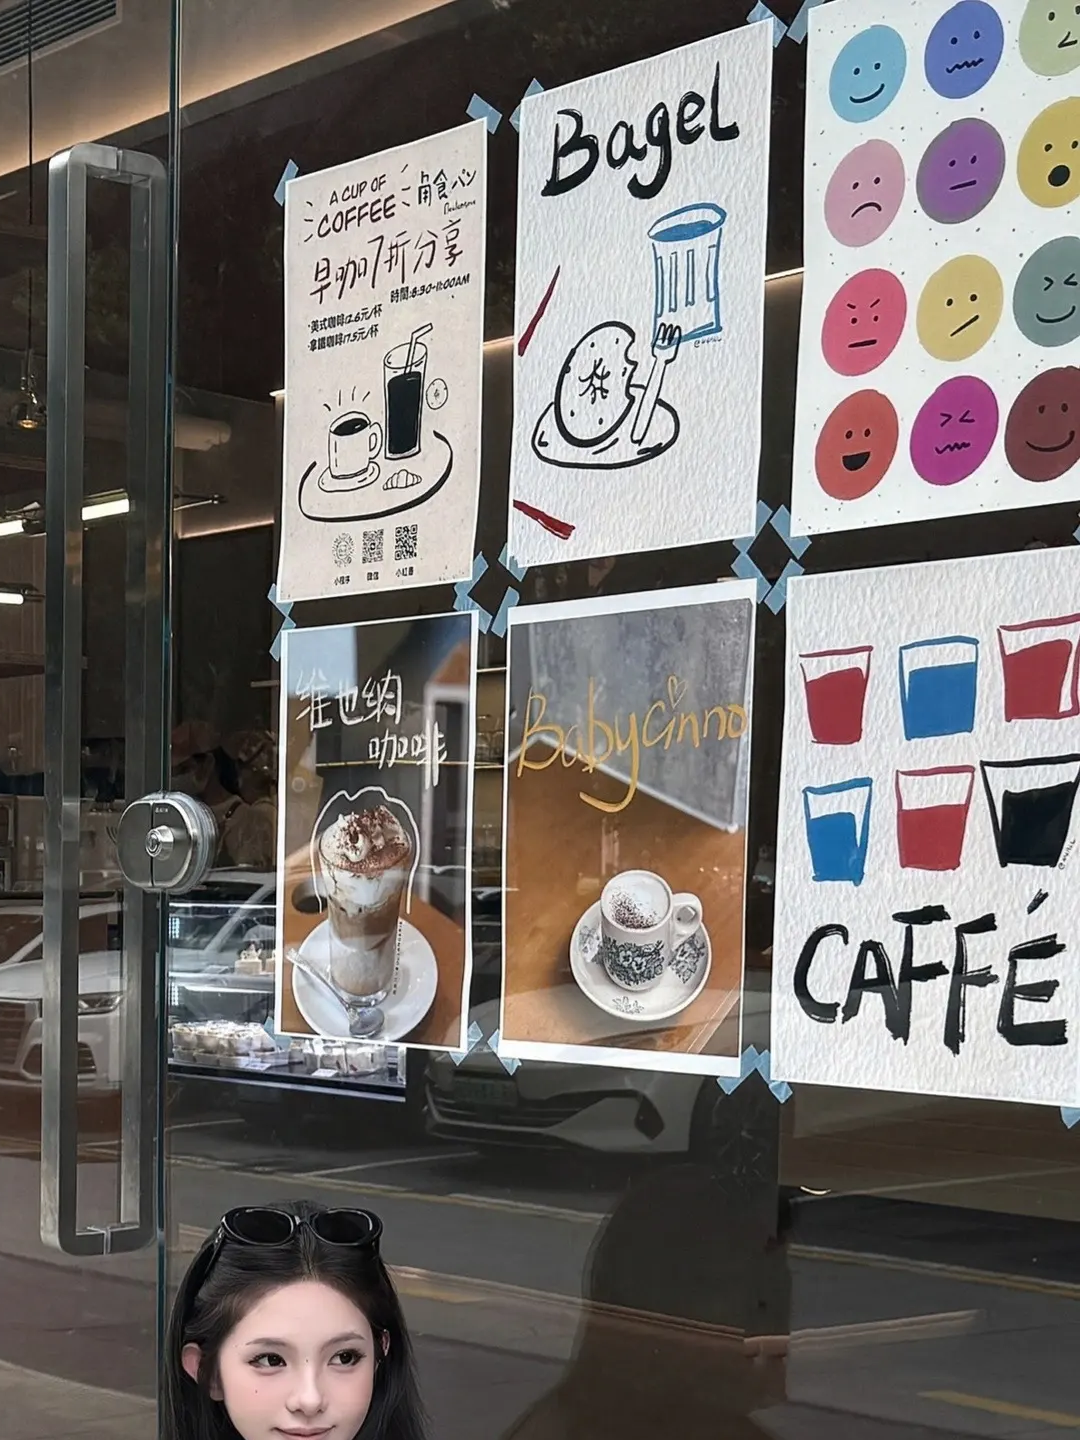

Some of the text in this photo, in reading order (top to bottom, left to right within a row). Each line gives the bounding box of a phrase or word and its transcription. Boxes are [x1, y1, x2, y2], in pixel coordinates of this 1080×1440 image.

[317, 194, 397, 239] COFFEE
[329, 174, 387, 207] A CUP OF
[309, 218, 464, 305] 早咖7折分享
[368, 719, 448, 791] 咖啡
[793, 889, 1069, 1058] CAFFÉ
